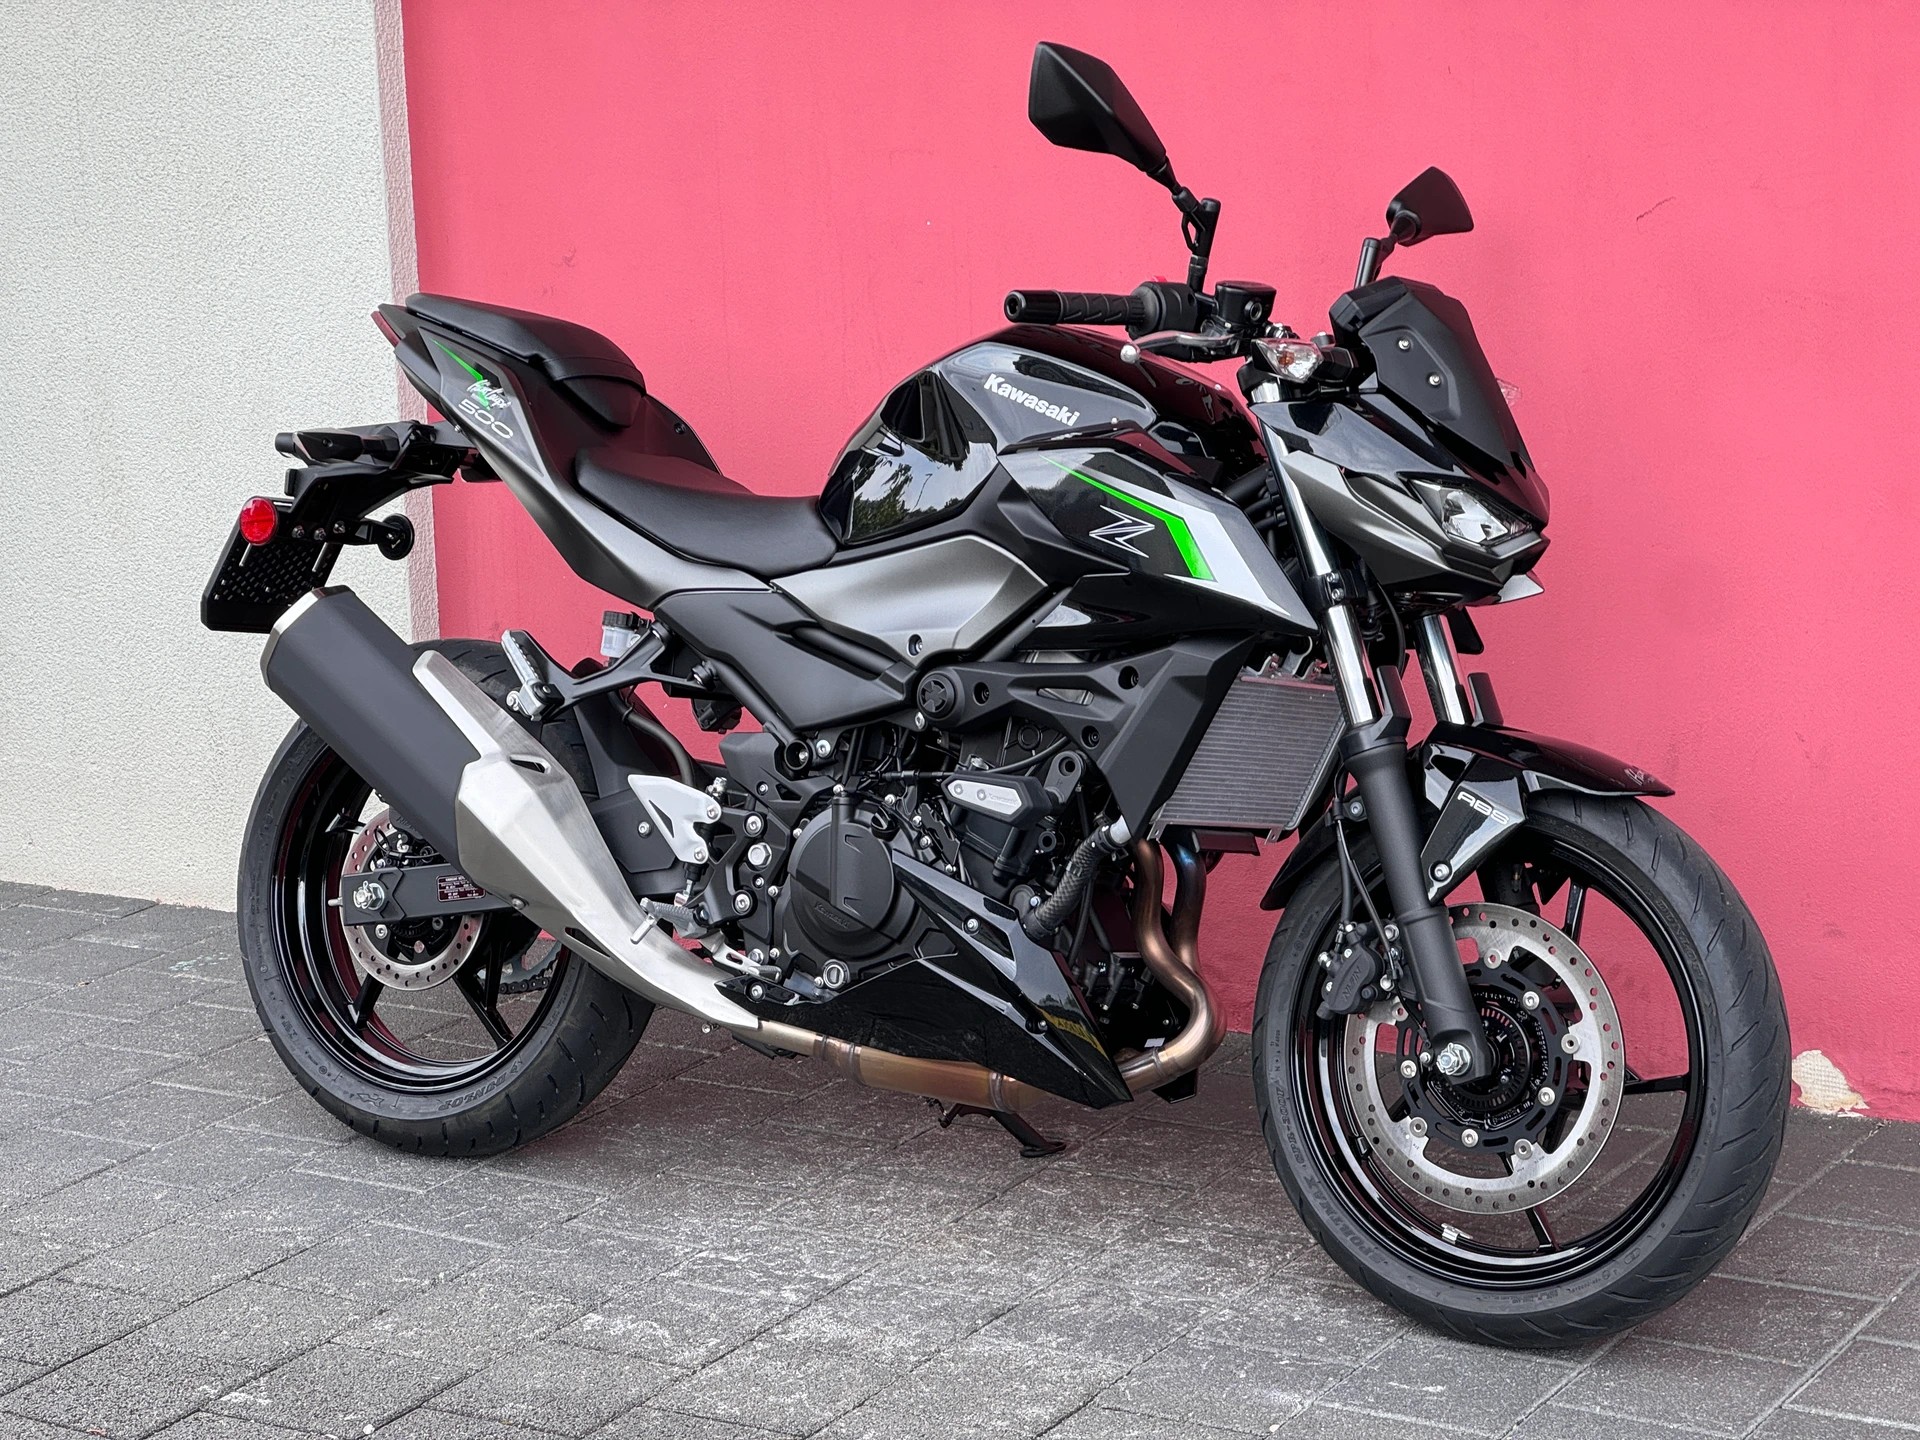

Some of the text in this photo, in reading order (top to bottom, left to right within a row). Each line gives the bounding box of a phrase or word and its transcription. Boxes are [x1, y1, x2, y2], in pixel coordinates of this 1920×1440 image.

[458, 398, 514, 439] 500
[983, 373, 1081, 427] Kawasaki
[1088, 503, 1156, 559] Z
[1456, 791, 1510, 825] ABS
[437, 1072, 507, 1112] DUNLOP
